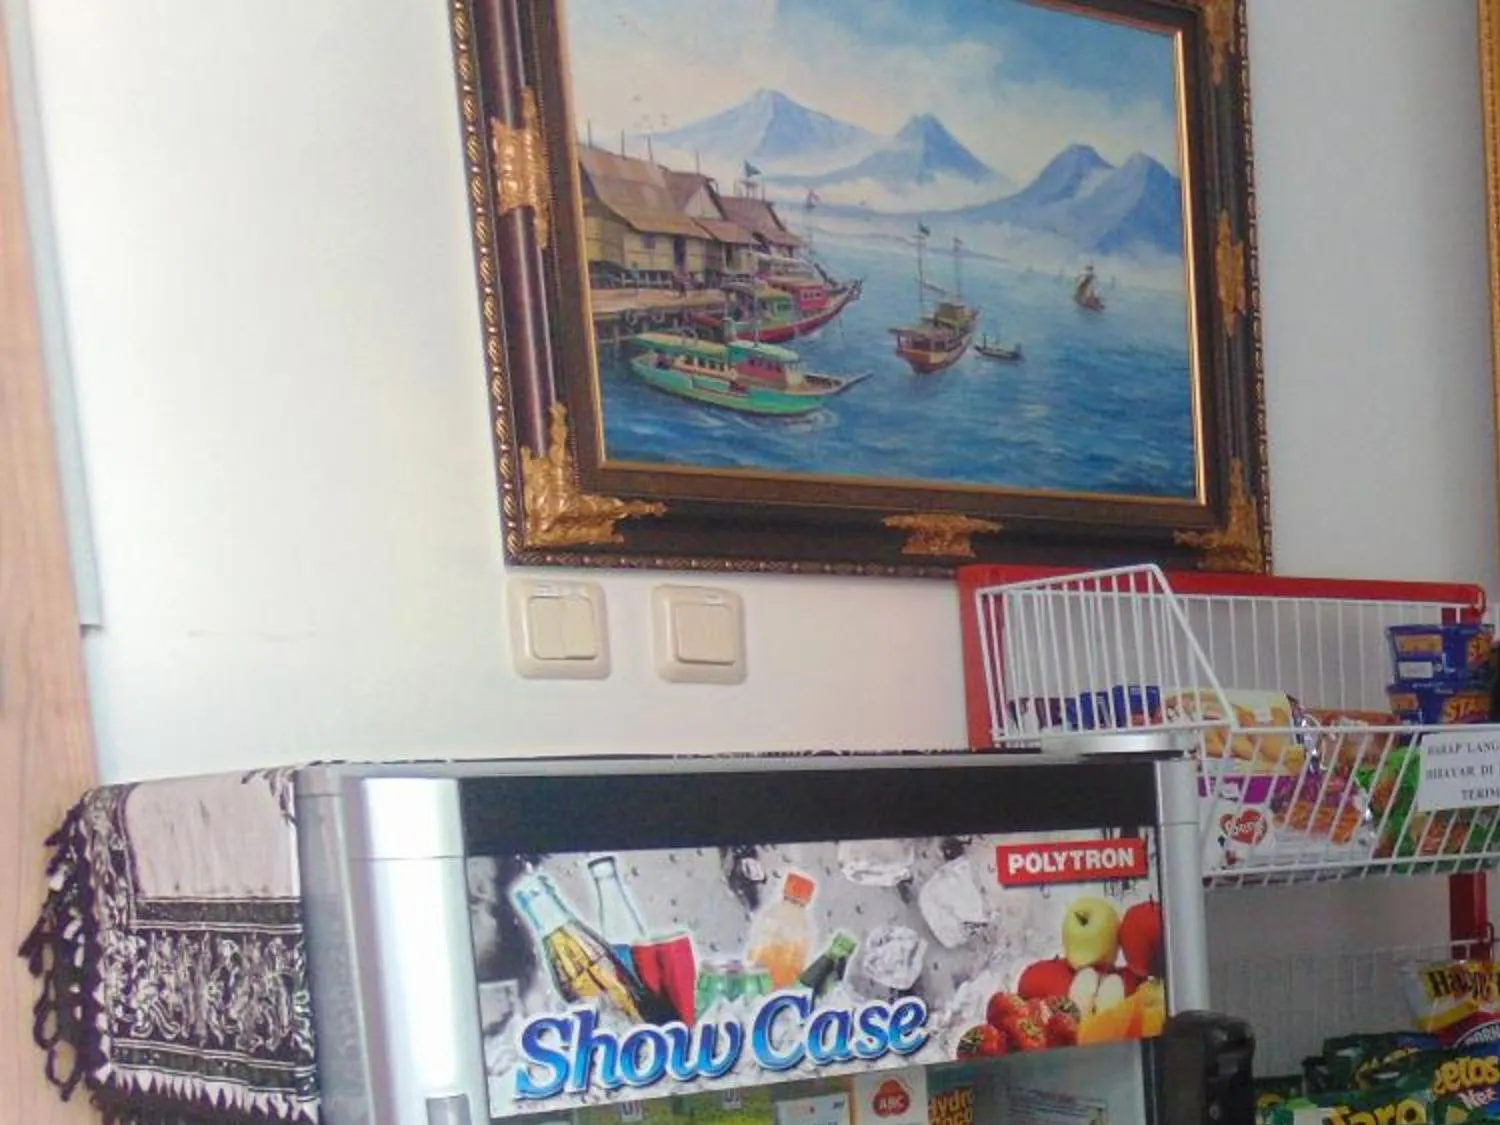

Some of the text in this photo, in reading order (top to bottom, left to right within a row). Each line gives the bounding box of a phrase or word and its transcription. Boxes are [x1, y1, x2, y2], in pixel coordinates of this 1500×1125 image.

[1007, 847, 1135, 875] POLYTRON
[513, 985, 929, 1099] Show Case
